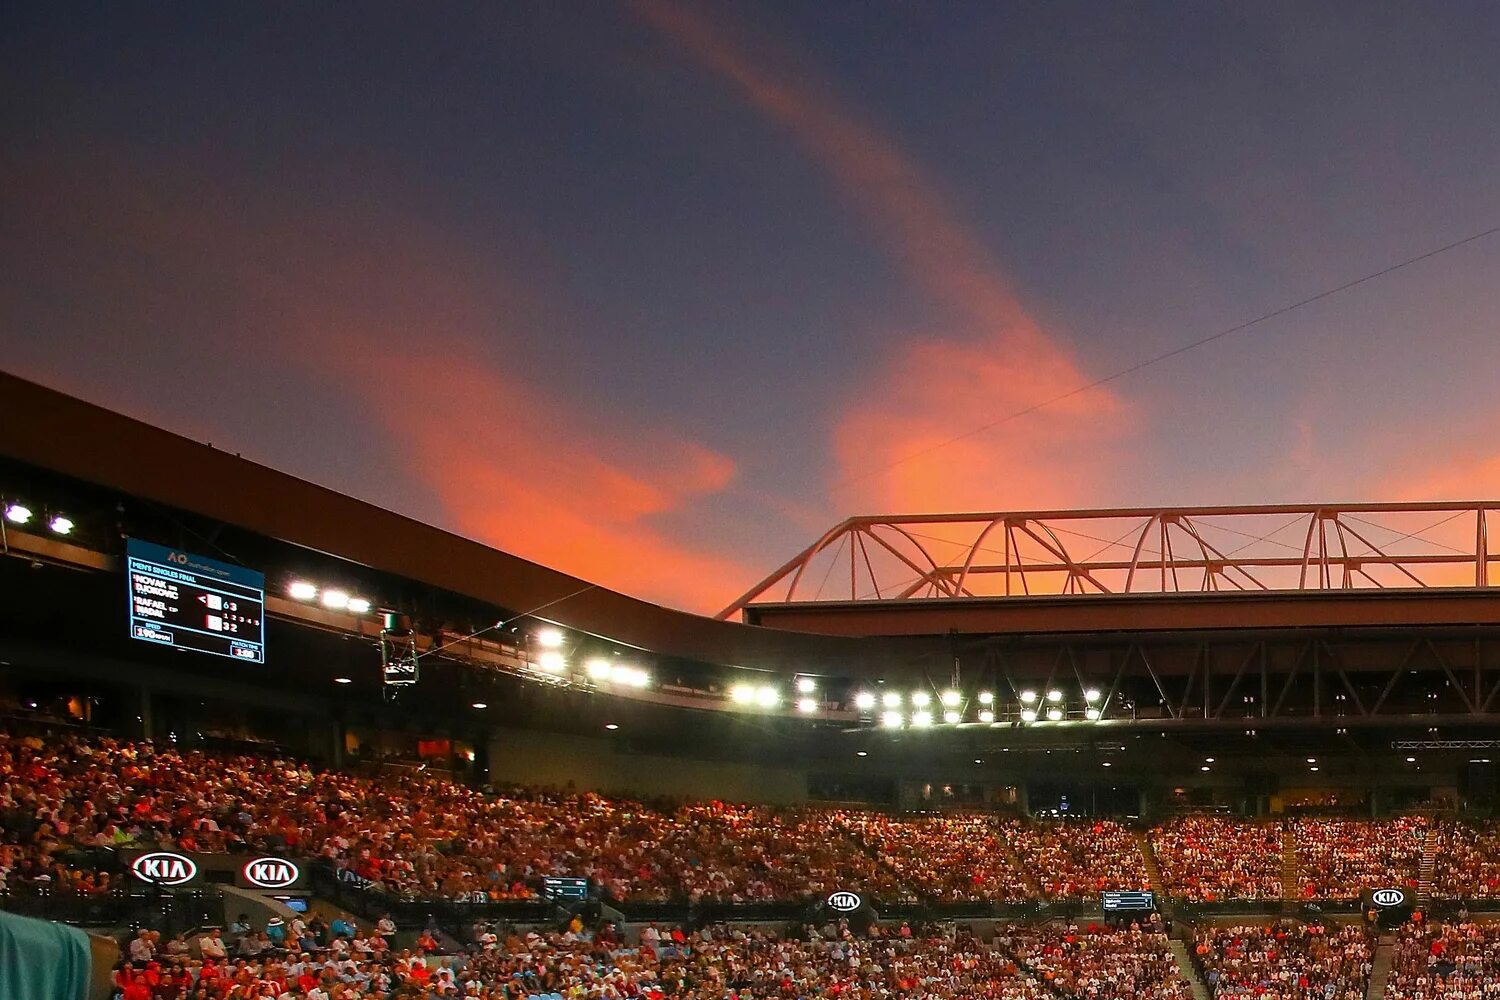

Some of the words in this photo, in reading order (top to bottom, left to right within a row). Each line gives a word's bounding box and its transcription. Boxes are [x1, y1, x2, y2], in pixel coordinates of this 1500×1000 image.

[135, 575, 167, 589] NOVAK
[223, 601, 229, 610] 6
[229, 602, 238, 612] 3
[222, 621, 230, 631] 3
[230, 623, 238, 633] 2
[144, 859, 187, 878] KIA
[253, 864, 290, 881] KIA
